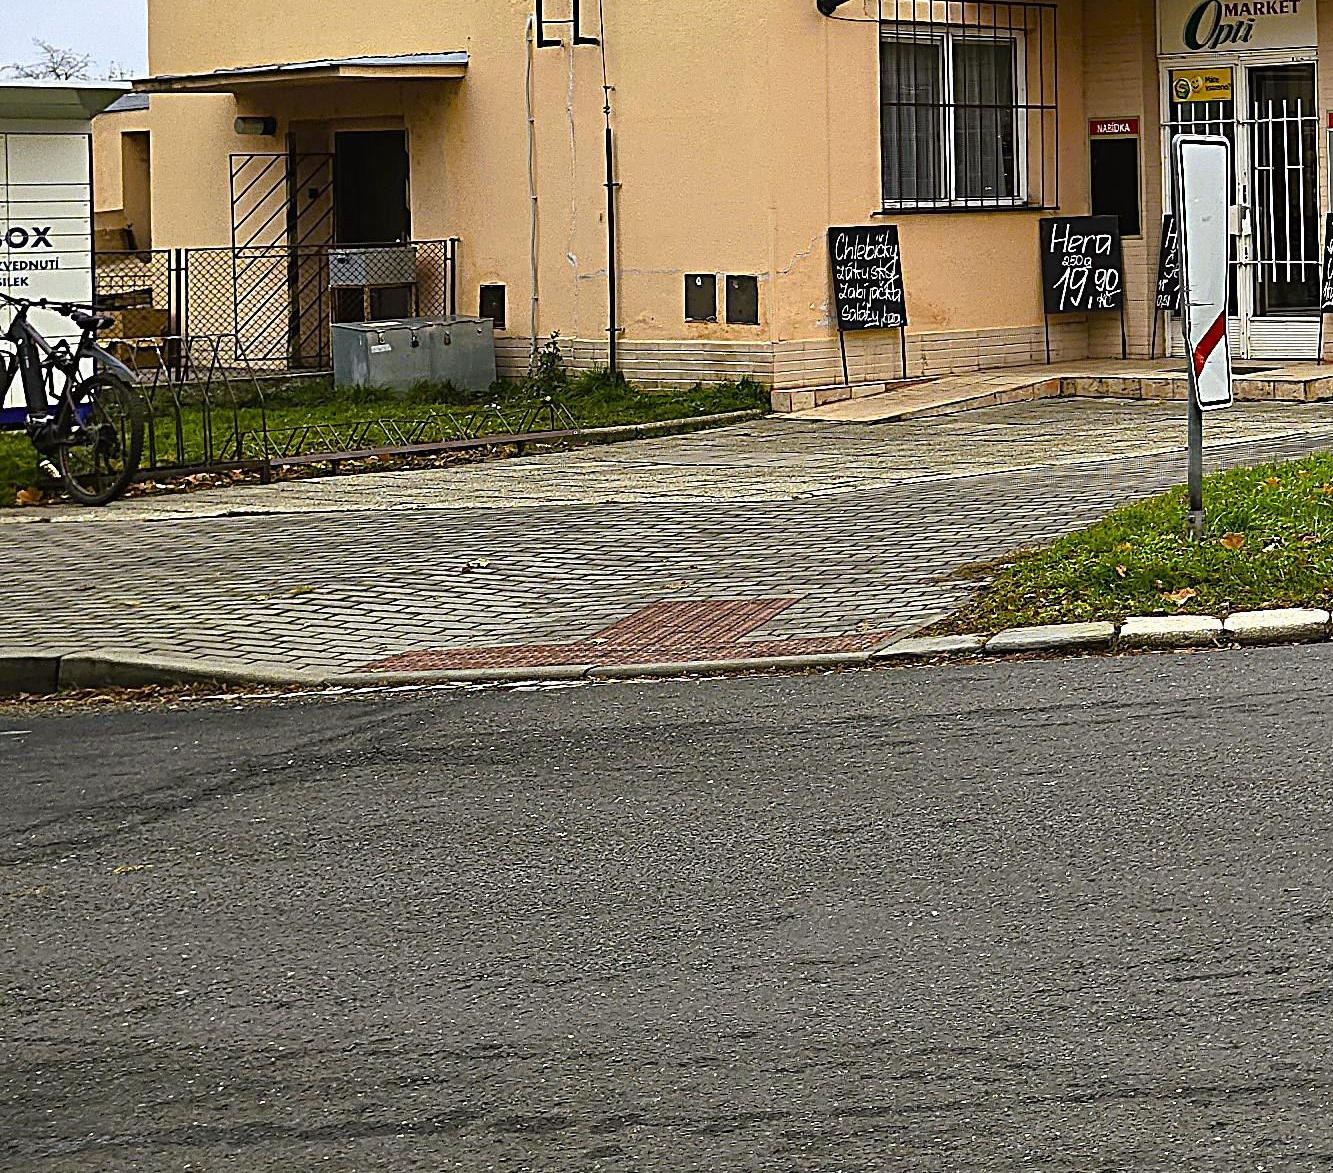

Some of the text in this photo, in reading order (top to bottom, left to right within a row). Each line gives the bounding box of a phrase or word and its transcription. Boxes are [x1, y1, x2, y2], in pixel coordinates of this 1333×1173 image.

[1224, 0, 1301, 17] MARKET
[1184, 0, 1256, 50] Opti
[1097, 121, 1130, 133] NABÍDKA
[0, 226, 53, 249] OX
[1050, 224, 1112, 255] Hera
